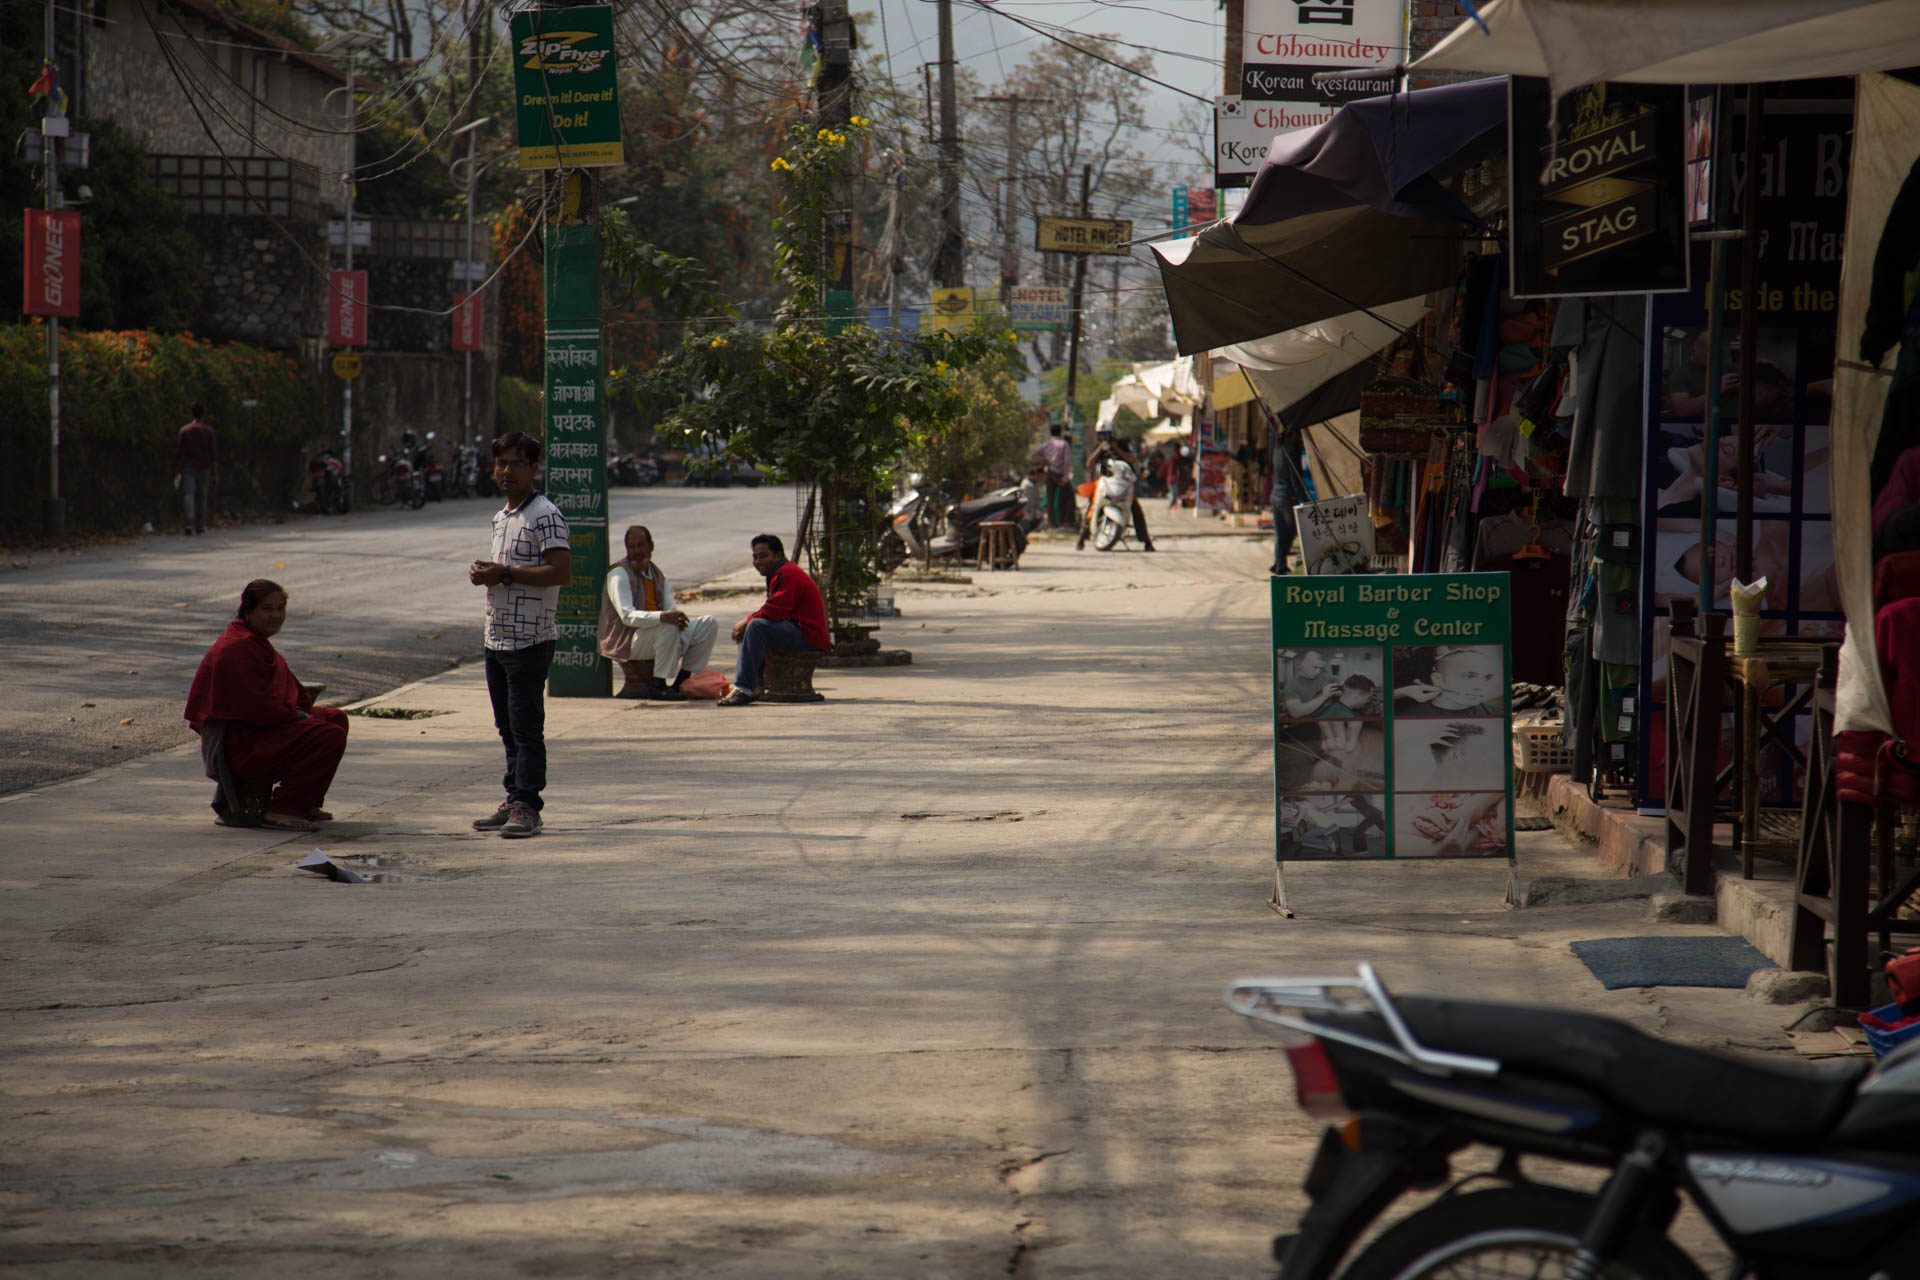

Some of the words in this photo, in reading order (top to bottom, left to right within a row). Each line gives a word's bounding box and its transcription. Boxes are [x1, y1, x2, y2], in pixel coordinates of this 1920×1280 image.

[559, 50, 610, 61] Flyer
[1257, 34, 1389, 63] Chhaundey
[574, 91, 600, 103] Dare
[601, 88, 613, 101] it!
[1246, 70, 1304, 95] Korean
[1312, 76, 1396, 97] Restaurant
[553, 114, 572, 128] Do
[574, 111, 589, 127] it!
[1548, 130, 1646, 184] ROYAL
[1055, 226, 1088, 243] HOTEL
[1562, 206, 1638, 251] STAG
[1016, 289, 1064, 302] HOTEL
[1793, 281, 1835, 311] the
[1285, 585, 1345, 608] Royal
[1358, 584, 1432, 603] Barber
[1446, 583, 1501, 604] Shop
[1386, 607, 1400, 620] &
[1304, 620, 1400, 642] Massage
[1414, 618, 1484, 637] Center
